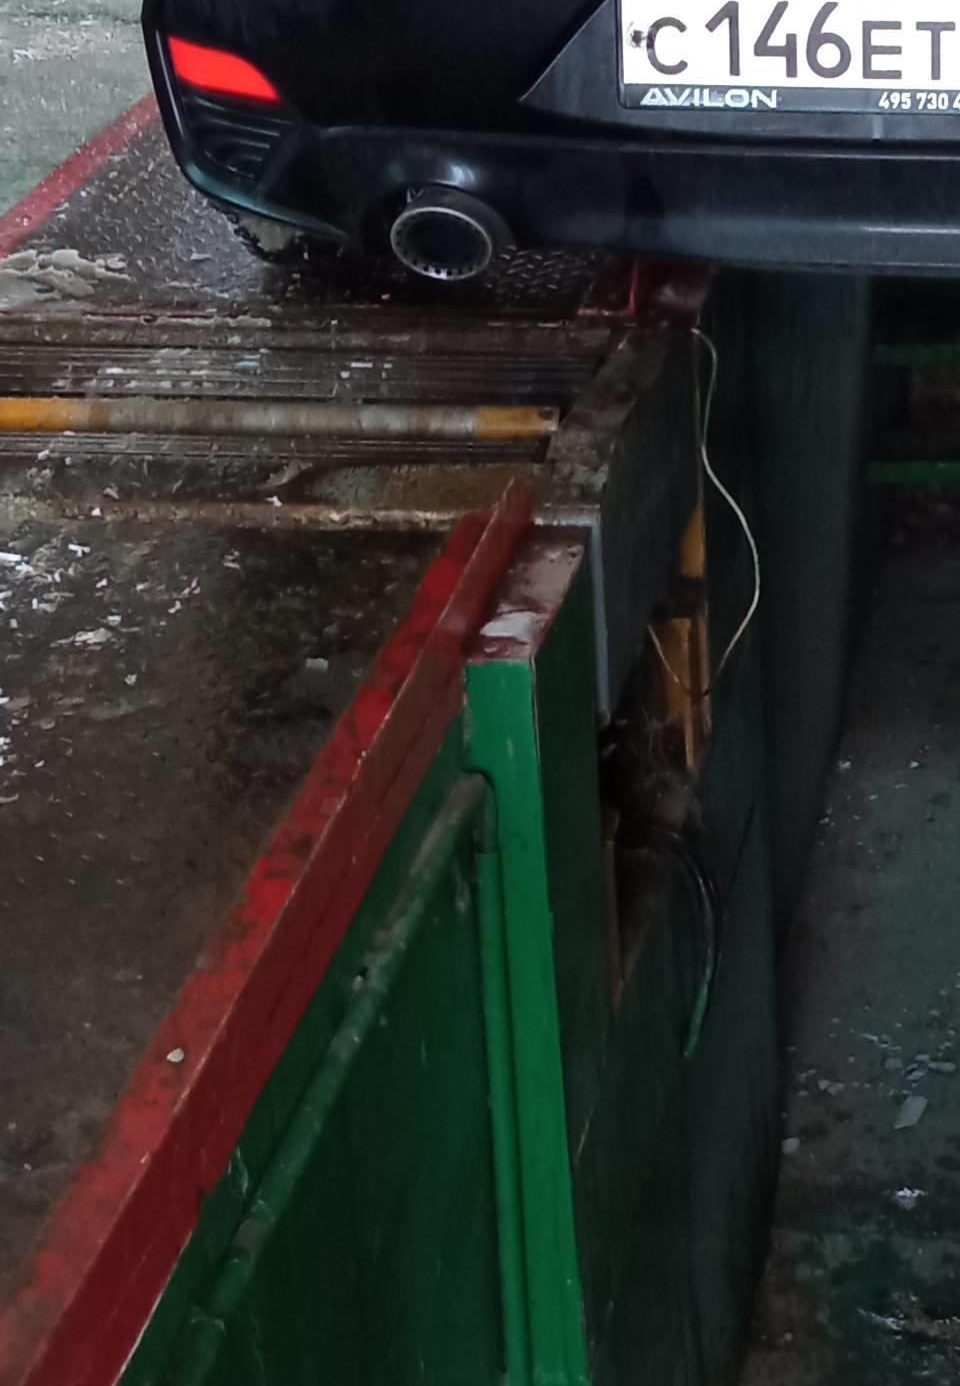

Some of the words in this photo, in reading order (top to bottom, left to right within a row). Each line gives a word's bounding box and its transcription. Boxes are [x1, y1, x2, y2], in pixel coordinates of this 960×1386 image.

[639, 87, 778, 109] AVILON
[878, 92, 912, 110] 495
[916, 92, 949, 111] 730
